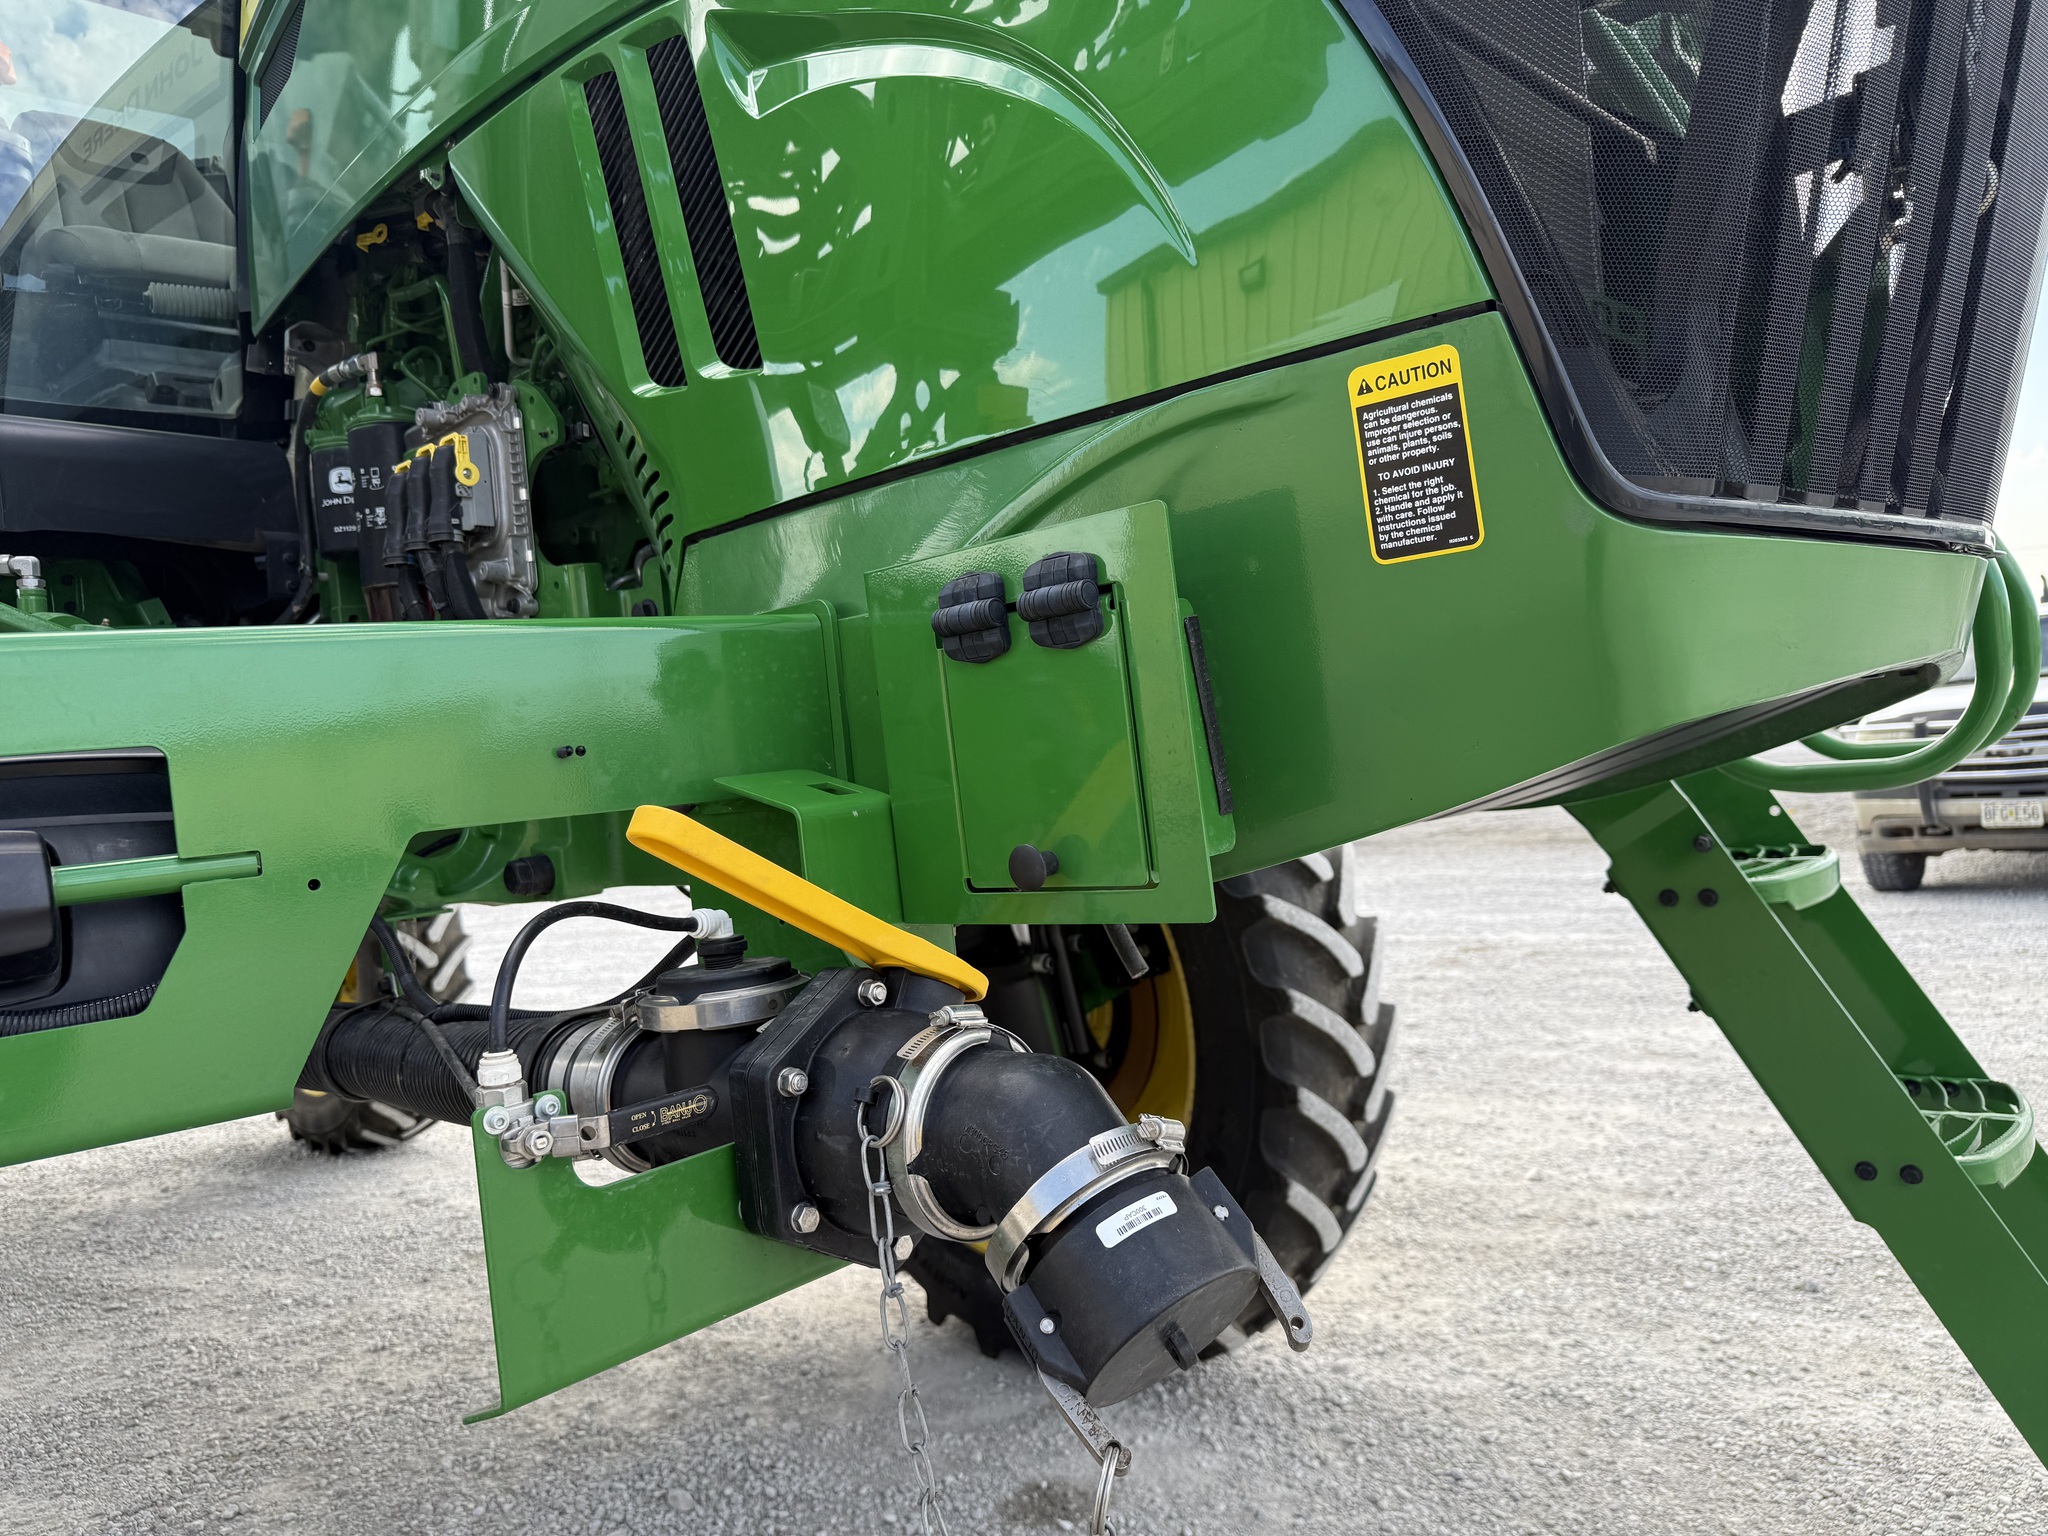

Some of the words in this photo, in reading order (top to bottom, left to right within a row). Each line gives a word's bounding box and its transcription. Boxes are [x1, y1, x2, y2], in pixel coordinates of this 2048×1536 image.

[1375, 358, 1452, 391] CAUTION
[1362, 401, 1409, 421] Agricultural
[1411, 392, 1453, 409] chemicals
[1363, 421, 1378, 430] can
[1380, 417, 1390, 427] be
[1391, 408, 1438, 422] dangerous.
[1364, 424, 1401, 439] Improper
[1402, 415, 1440, 430] selection
[1442, 412, 1452, 421] or
[1366, 439, 1381, 448] use
[1382, 435, 1397, 444] can
[1399, 428, 1422, 441] injure
[1424, 420, 1461, 436] persons,
[1367, 444, 1401, 457] animals,
[1402, 437, 1431, 450] plants,
[1432, 431, 1453, 443] soils
[1368, 458, 1378, 466] or
[1379, 451, 1400, 464] other
[1402, 445, 1440, 460] property.
[1378, 472, 1391, 481] TO
[1392, 465, 1420, 479] AVOID
[1422, 458, 1456, 472] INJURY
[1373, 489, 1380, 497] 1.
[1381, 484, 1407, 496] Select
[1409, 480, 1422, 490] the
[1424, 475, 1444, 488] right
[1374, 492, 1410, 506] chemical
[1412, 489, 1424, 498] for
[1425, 486, 1439, 496] the
[1440, 483, 1457, 494] job.
[321, 497, 342, 508] JOHN
[1375, 507, 1383, 515] 2.
[1384, 502, 1413, 513] Handle
[1415, 497, 1430, 507] and
[1432, 492, 1455, 506] apply
[1457, 490, 1464, 499] it
[1376, 513, 1394, 524] with
[1395, 511, 1415, 520] care.
[1417, 504, 1445, 516] Follow
[1378, 517, 1427, 533] instructions
[1428, 511, 1457, 524] issued
[1379, 532, 1389, 542] by
[1391, 528, 1404, 539] the
[1406, 522, 1443, 537] chemical
[1380, 534, 1438, 550] manufacturer.
[631, 1111, 647, 1121] OPEN
[660, 1094, 707, 1123] BANJO
[632, 1123, 651, 1133] CLOSE
